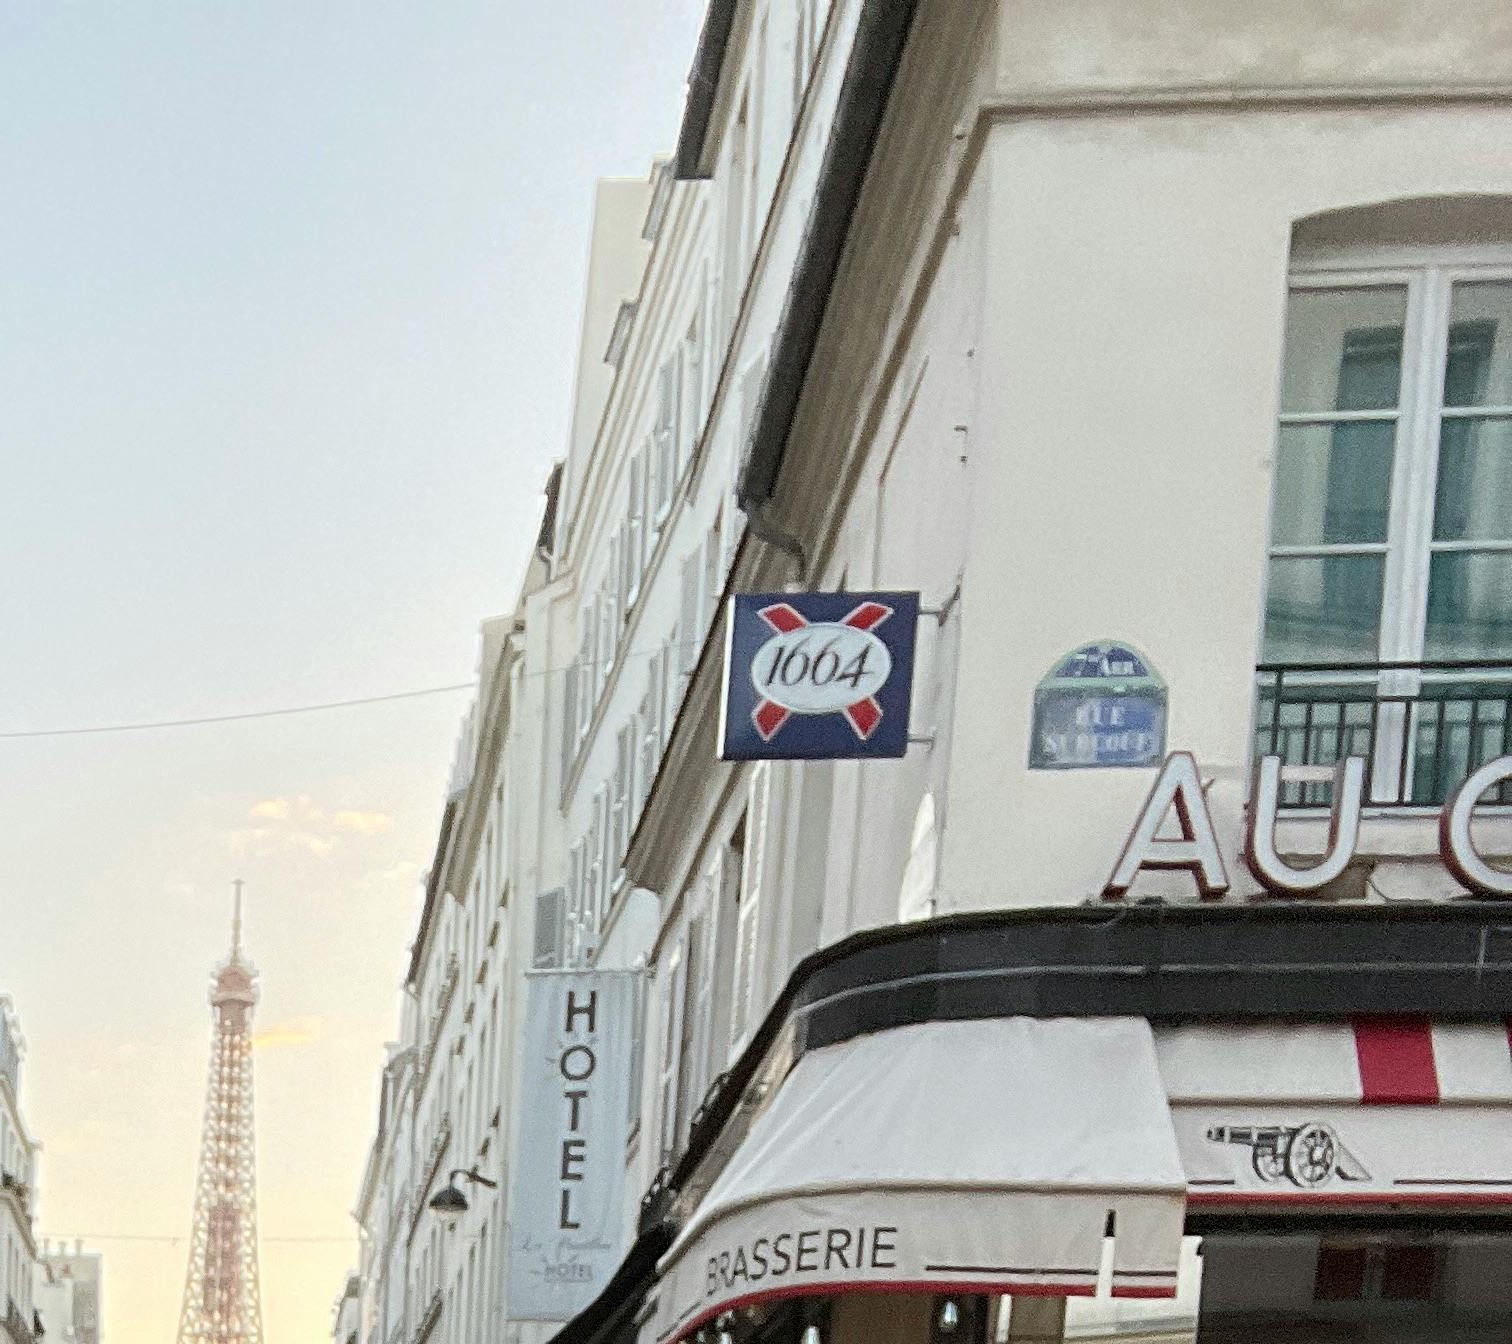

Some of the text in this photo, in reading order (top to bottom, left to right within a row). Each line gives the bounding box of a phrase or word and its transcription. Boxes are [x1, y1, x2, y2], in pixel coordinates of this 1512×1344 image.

[765, 636, 875, 688] 1664
[1101, 750, 1366, 902] AU
[559, 990, 597, 1230] HOTEL
[706, 1226, 897, 1297] BRASSERIE
